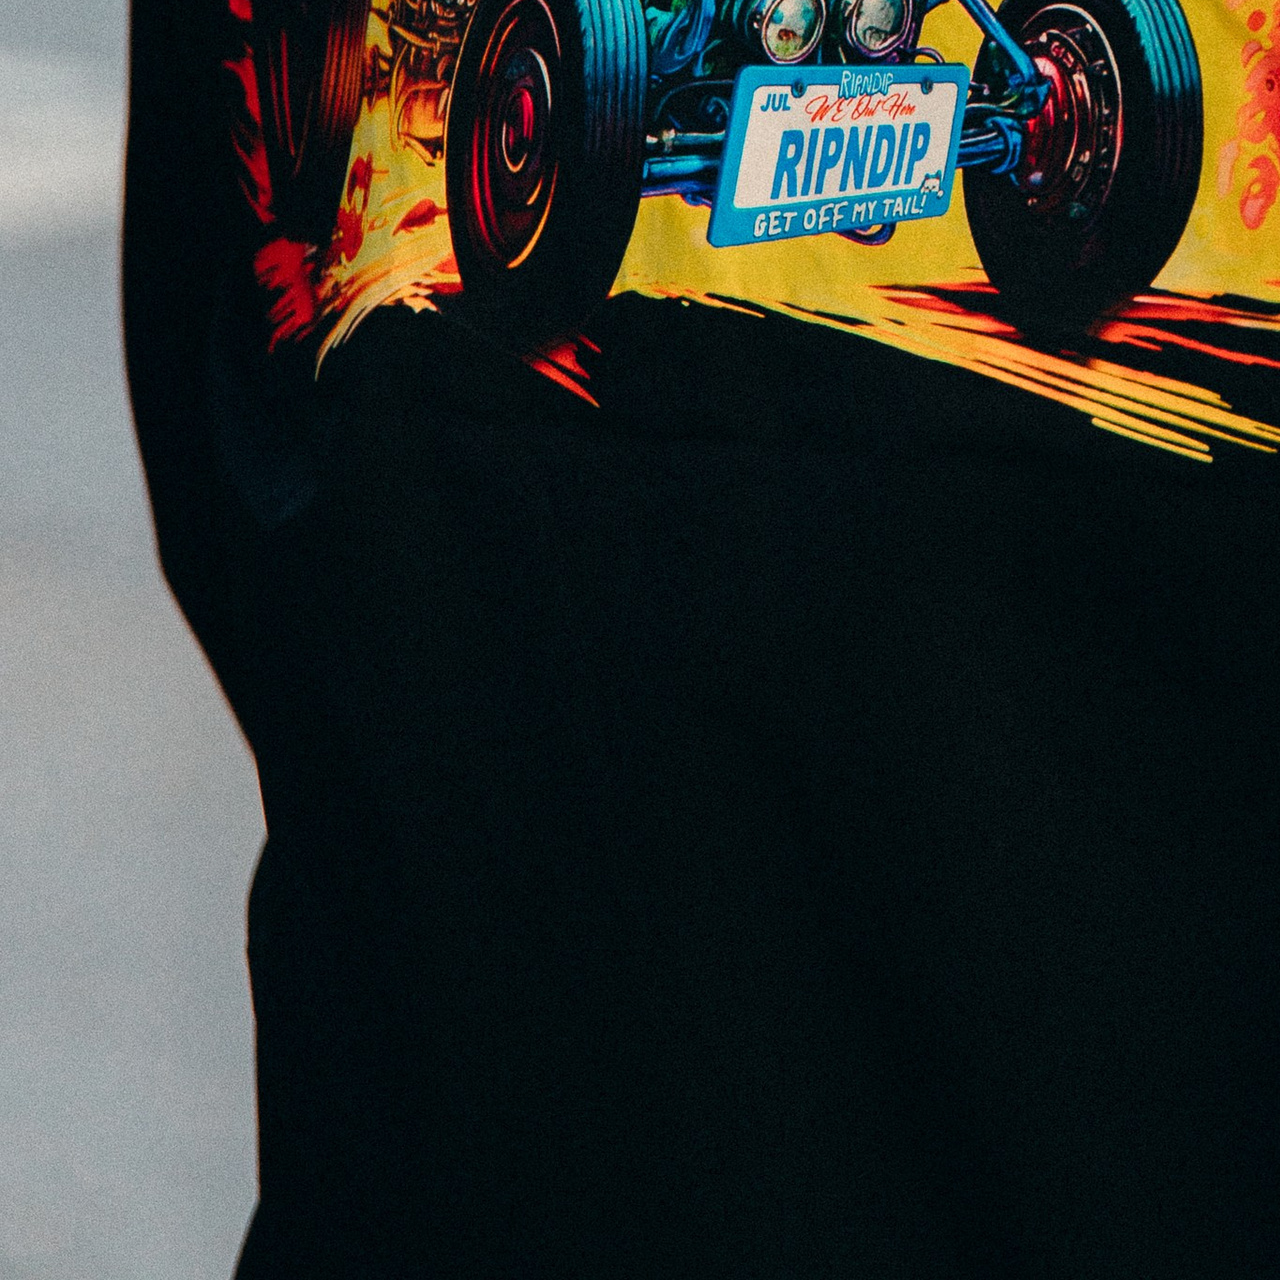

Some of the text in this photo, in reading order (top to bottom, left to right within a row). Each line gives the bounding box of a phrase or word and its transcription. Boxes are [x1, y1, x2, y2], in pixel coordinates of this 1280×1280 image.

[839, 70, 894, 98] RIPNDIP
[760, 93, 791, 112] JUL
[881, 91, 916, 120] Here
[770, 122, 931, 200] RIPNDIP
[753, 195, 927, 237] GET OFF MY TAIL!
